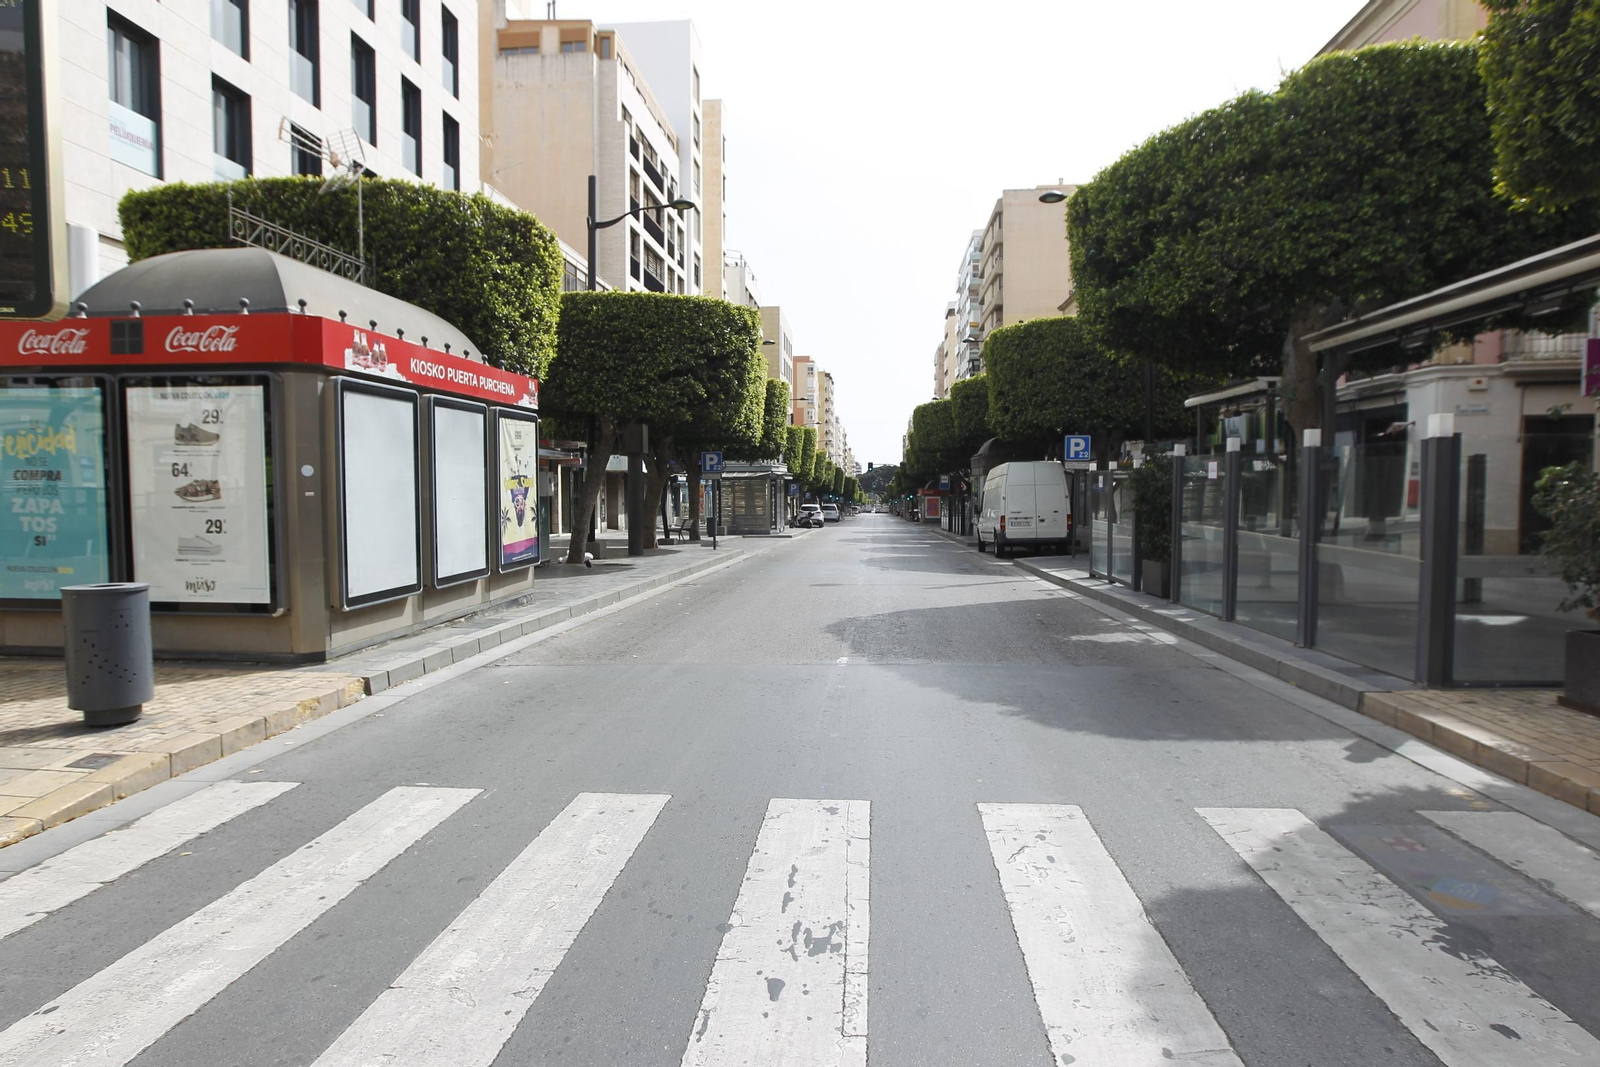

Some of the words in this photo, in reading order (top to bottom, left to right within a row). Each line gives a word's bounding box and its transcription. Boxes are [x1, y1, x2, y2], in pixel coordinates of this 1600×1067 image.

[2, 212, 33, 233] 45
[18, 328, 91, 355] Coca-Cola
[164, 325, 241, 352] Coca-Cola
[410, 358, 445, 380] KIOSKO
[447, 367, 478, 387] PUERTA
[479, 375, 515, 395] PURCHENA
[1070, 438, 1086, 458] P
[705, 454, 718, 470] P
[13, 469, 62, 481] COMPRA
[12, 498, 64, 515] ZAPA
[20, 516, 57, 533] TOS
